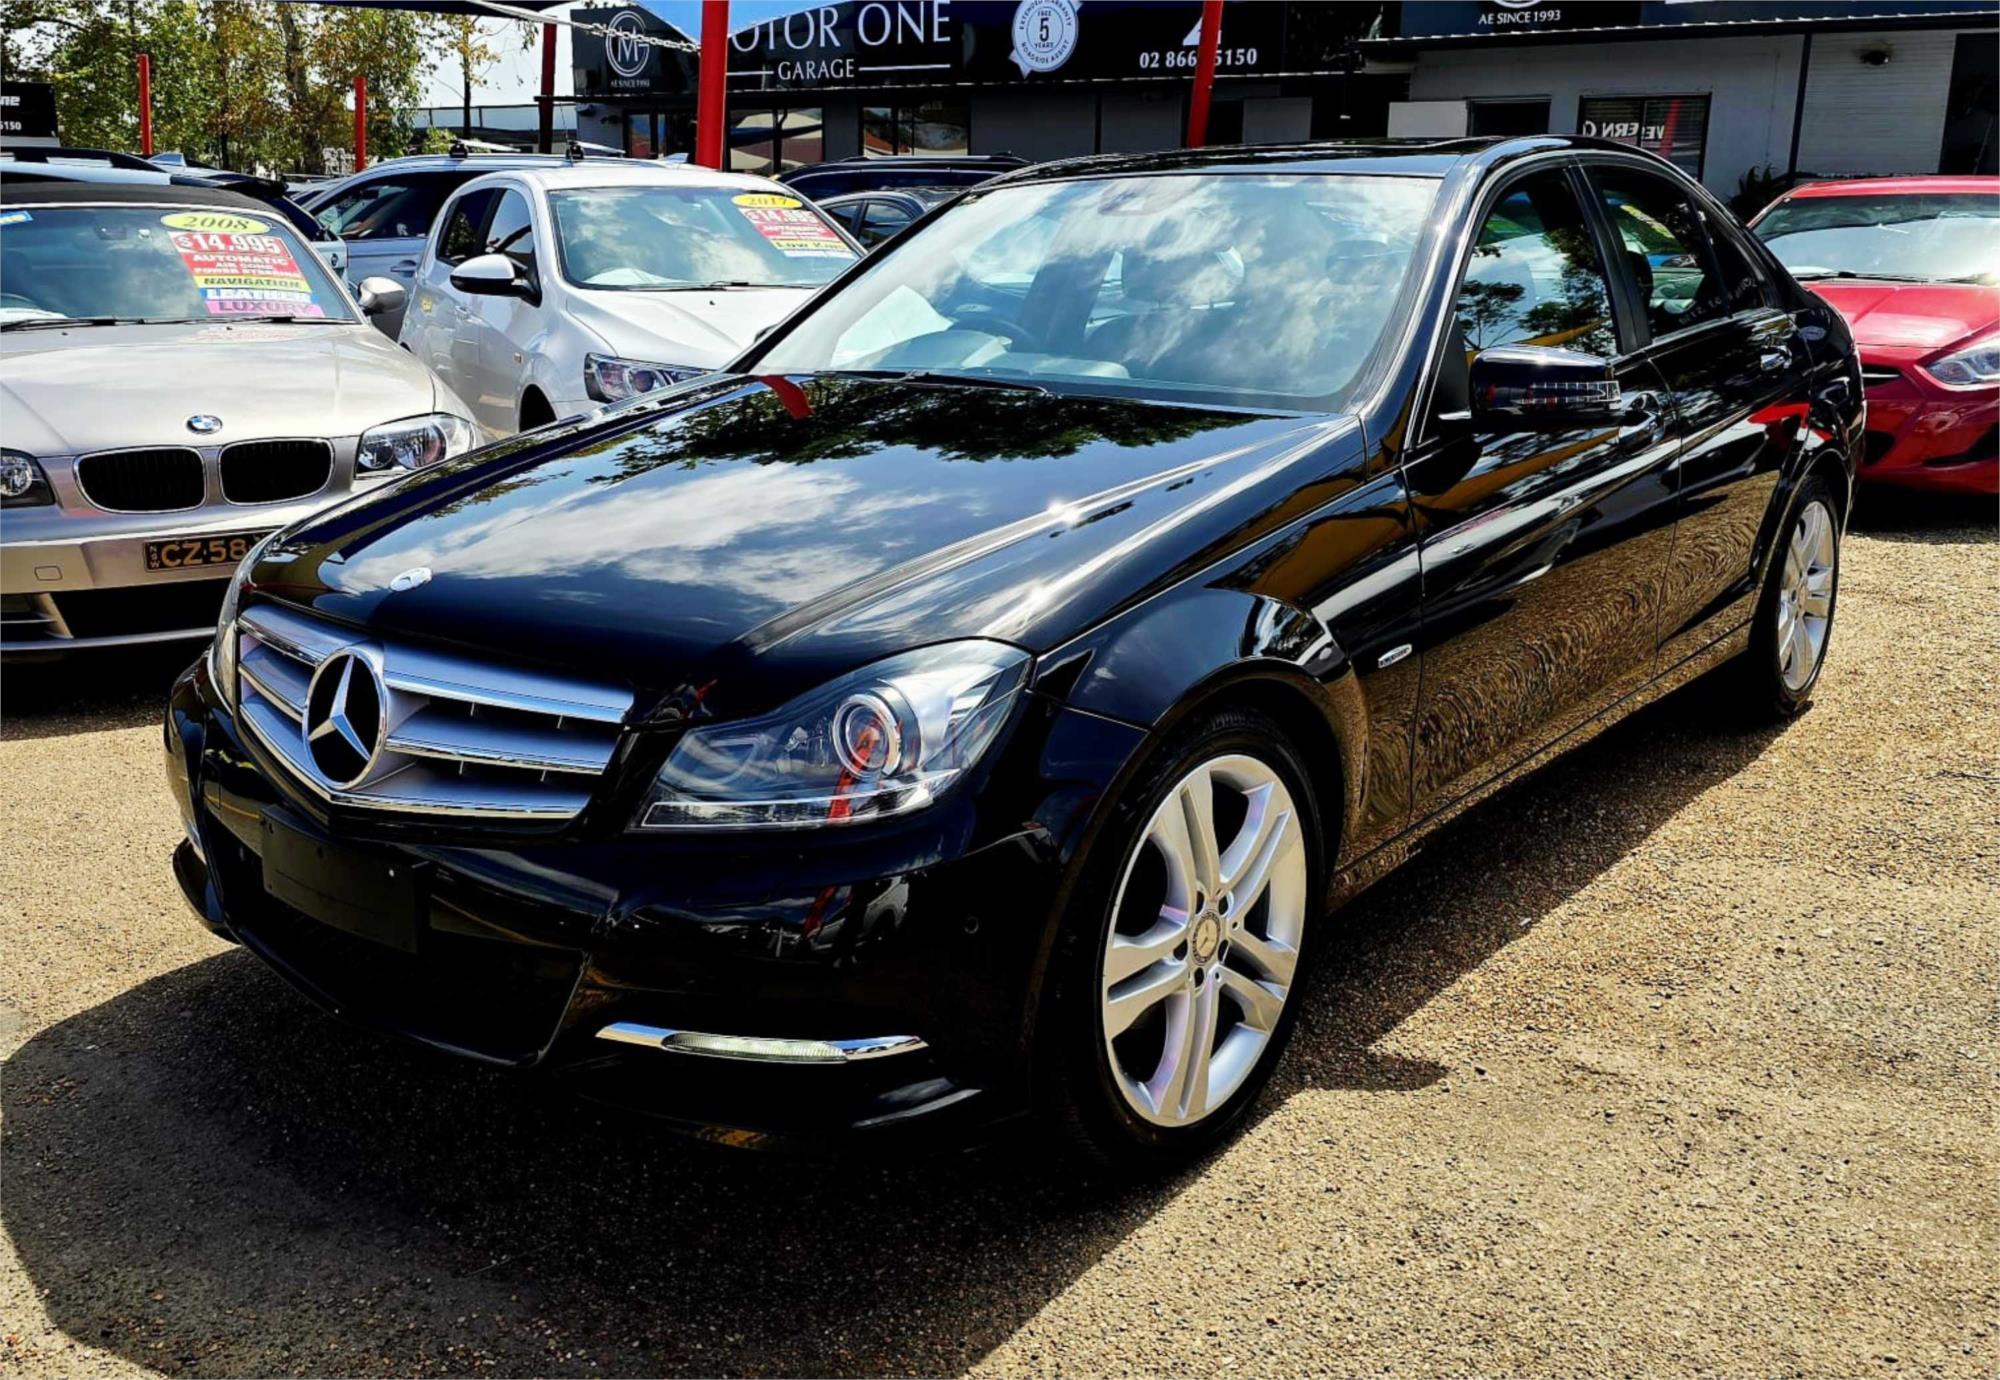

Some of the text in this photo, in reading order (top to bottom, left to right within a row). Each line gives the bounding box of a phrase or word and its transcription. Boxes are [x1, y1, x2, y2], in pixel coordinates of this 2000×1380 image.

[858, 0, 951, 46] ONE
[1478, 9, 1561, 25] AE SINCE 1993
[1040, 17, 1049, 42] 5
[1139, 52, 1160, 68] 02
[778, 59, 855, 80] GARAGE
[183, 216, 250, 230] 2008
[175, 233, 280, 253] $14,995
[192, 254, 289, 265] AUTOMATIC
[203, 277, 300, 288] NAVIGATION
[219, 301, 313, 313] LUXURY
